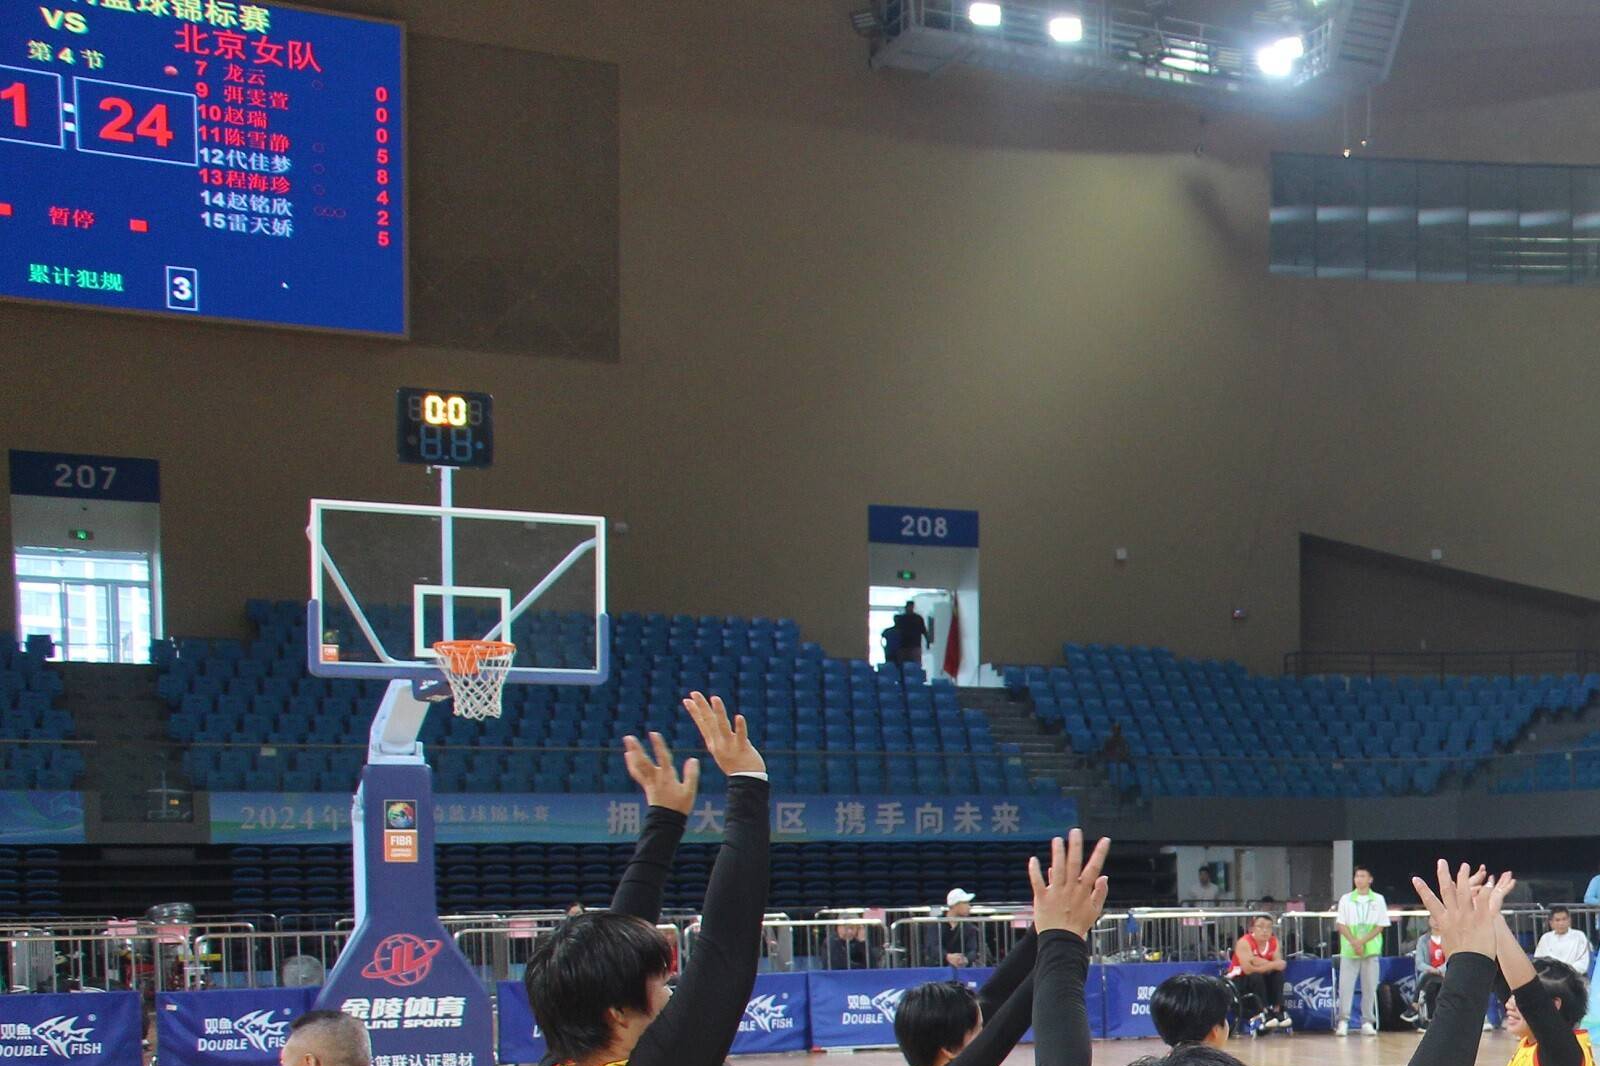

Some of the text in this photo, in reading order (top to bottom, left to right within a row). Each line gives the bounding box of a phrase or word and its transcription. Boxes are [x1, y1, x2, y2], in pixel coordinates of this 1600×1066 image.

[40, 6, 89, 34] VS
[174, 24, 323, 73] 北京女队
[194, 60, 388, 102] 7 龙云 0
[195, 82, 209, 98] 9
[375, 107, 388, 123] 0
[98, 97, 174, 148] 24
[197, 104, 223, 122] 10
[375, 128, 388, 144] 0
[198, 125, 222, 143] 11
[376, 148, 389, 164] 5
[199, 147, 389, 185] 12 代佳梦 8
[198, 167, 224, 186] 13
[376, 190, 389, 205] 4
[48, 206, 96, 230] 暂停
[200, 190, 226, 208] 14
[377, 210, 390, 226] 2
[201, 211, 227, 230] 15
[377, 231, 390, 247] 5
[28, 263, 125, 293] 累计犯规
[172, 276, 193, 300] 3
[54, 464, 117, 491] 207
[900, 515, 949, 539] 208
[607, 801, 1022, 836] 拥大区 携手向未来
[341, 996, 466, 1020] 金陵体育
[842, 1012, 884, 1026] DOUBLE
[364, 1018, 462, 1030] LING SPORTS
[738, 1017, 794, 1032] BLE FISH
[70, 1042, 102, 1055] FISH
[197, 1036, 287, 1052] DOUBLE FIS
